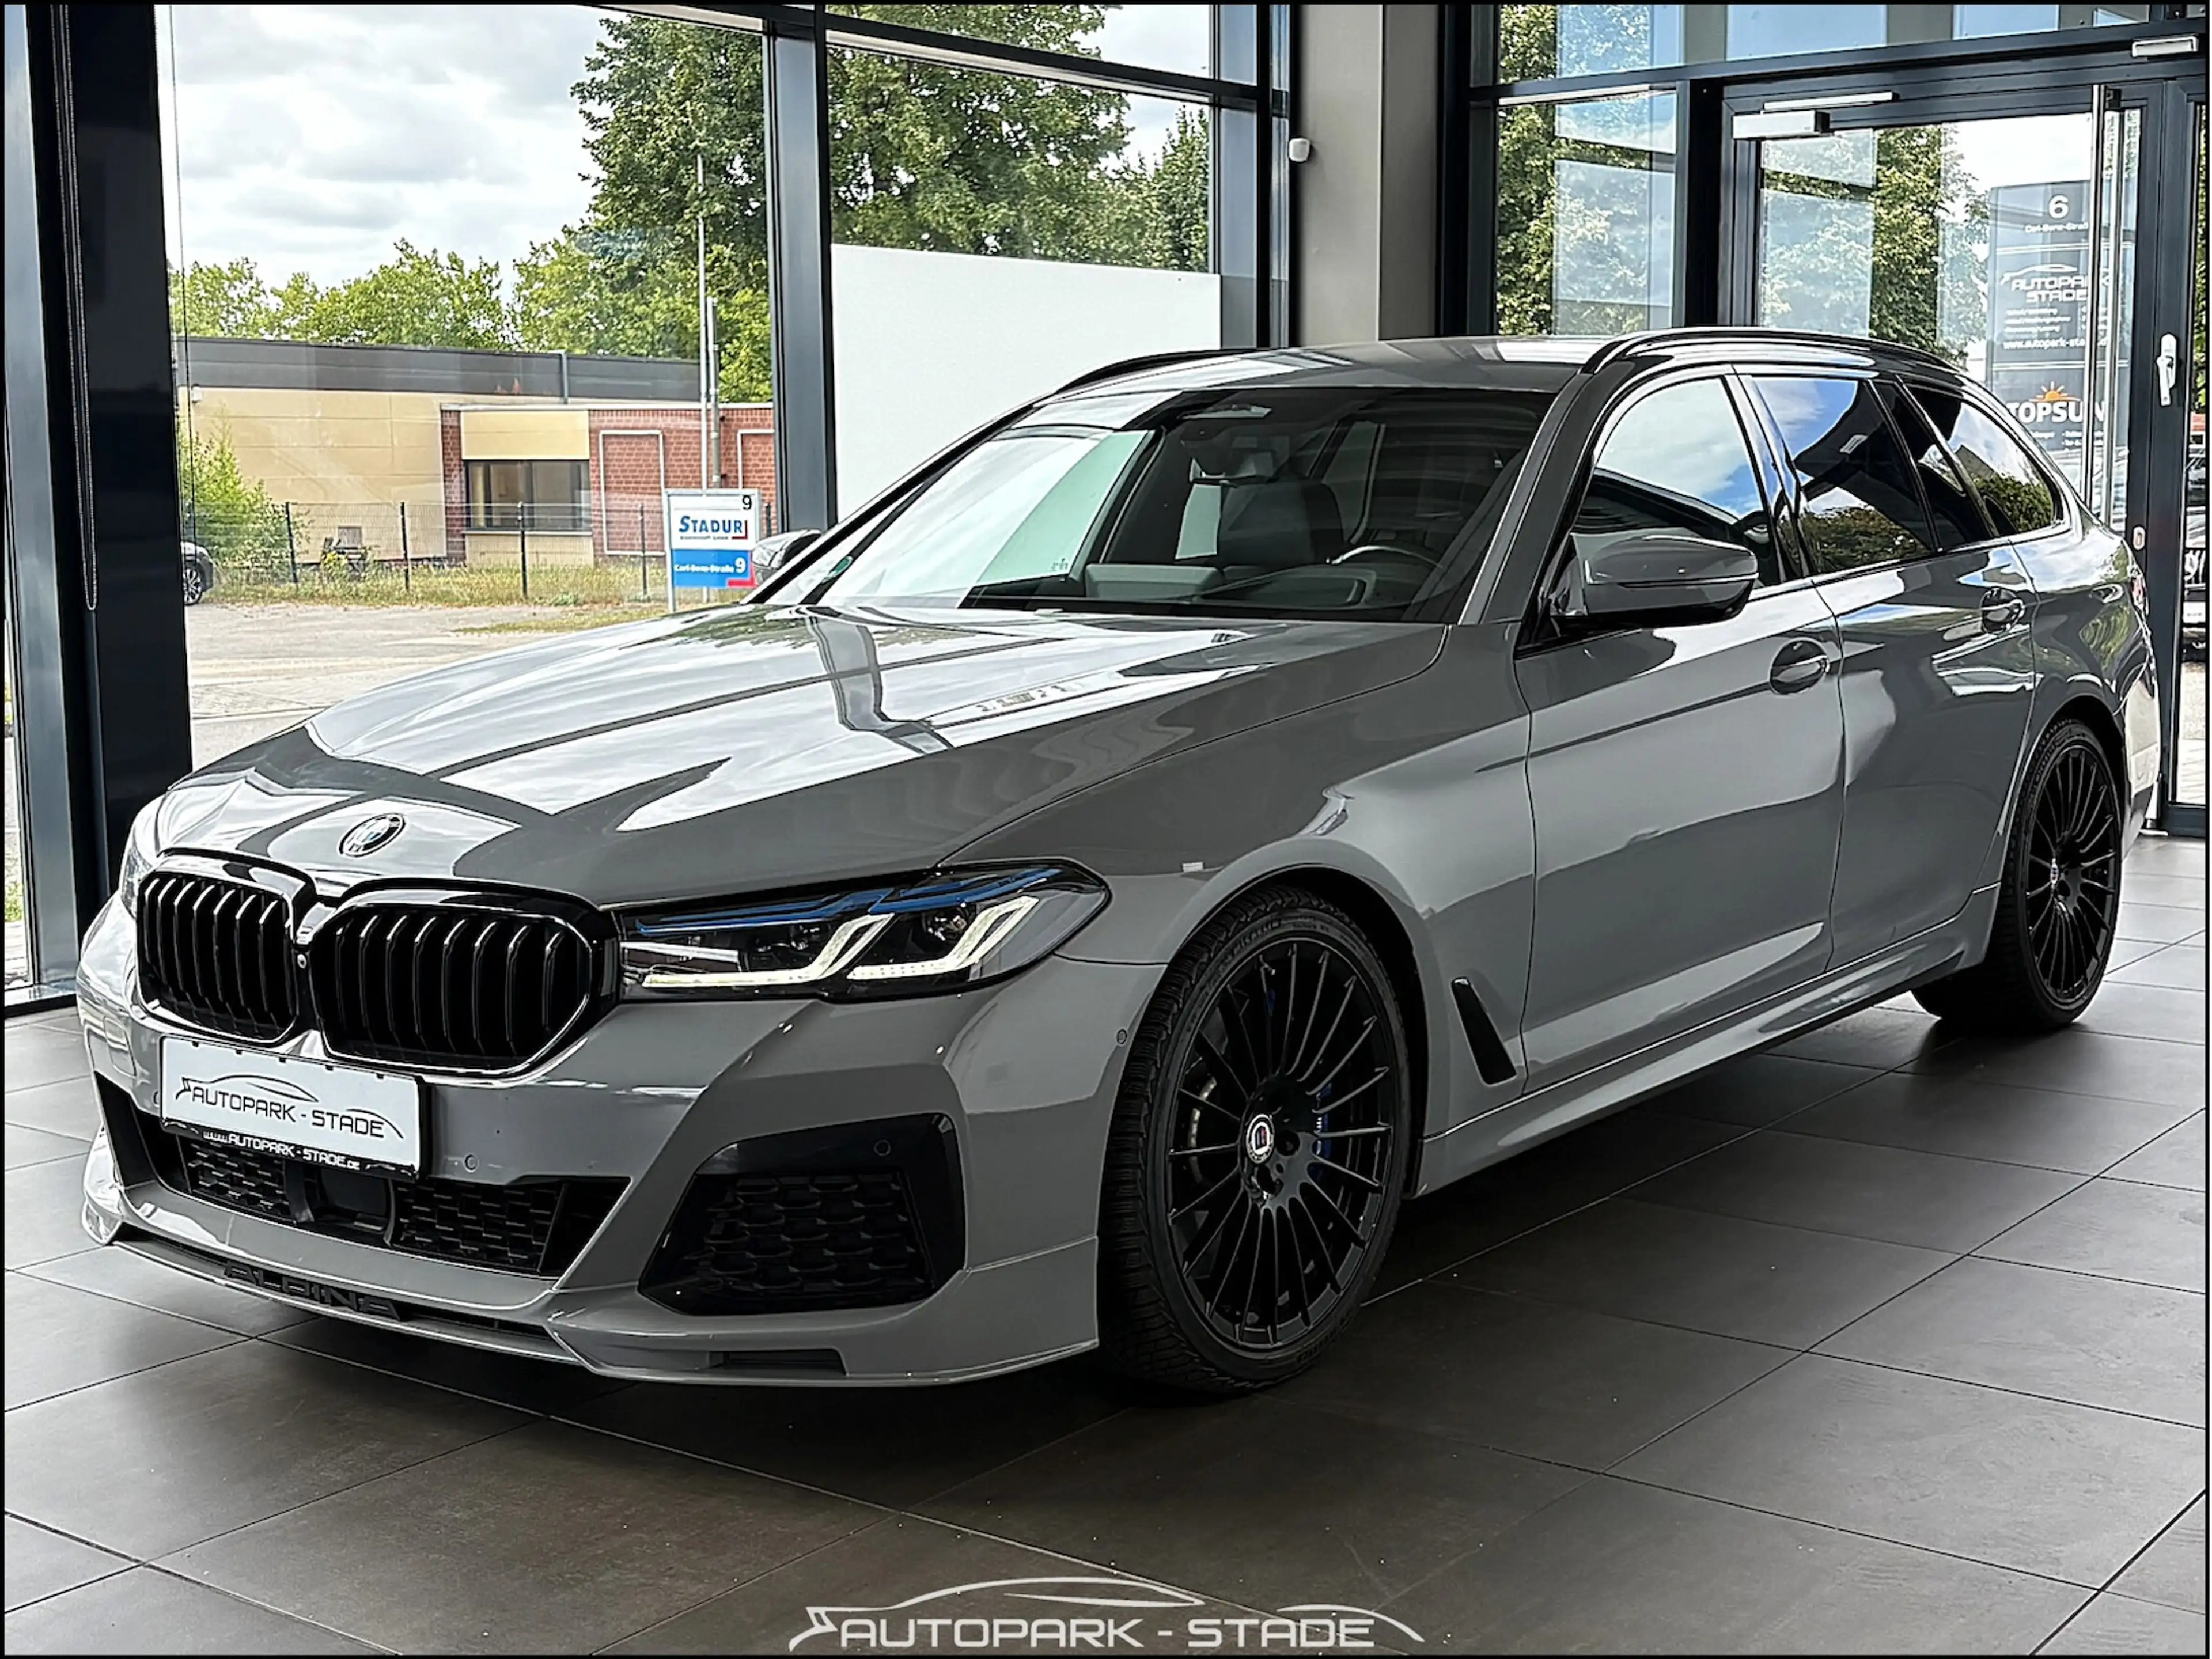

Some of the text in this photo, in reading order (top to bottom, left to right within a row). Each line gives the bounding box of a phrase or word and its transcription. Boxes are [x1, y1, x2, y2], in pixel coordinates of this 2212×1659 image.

[2048, 194, 2070, 219] 6
[2025, 289, 2088, 303] STADE
[742, 495, 752, 510] 9
[679, 515, 743, 533] STADUR
[735, 556, 747, 574] 9
[192, 1086, 296, 1123] AUTOPARK
[312, 1110, 385, 1138] STADE
